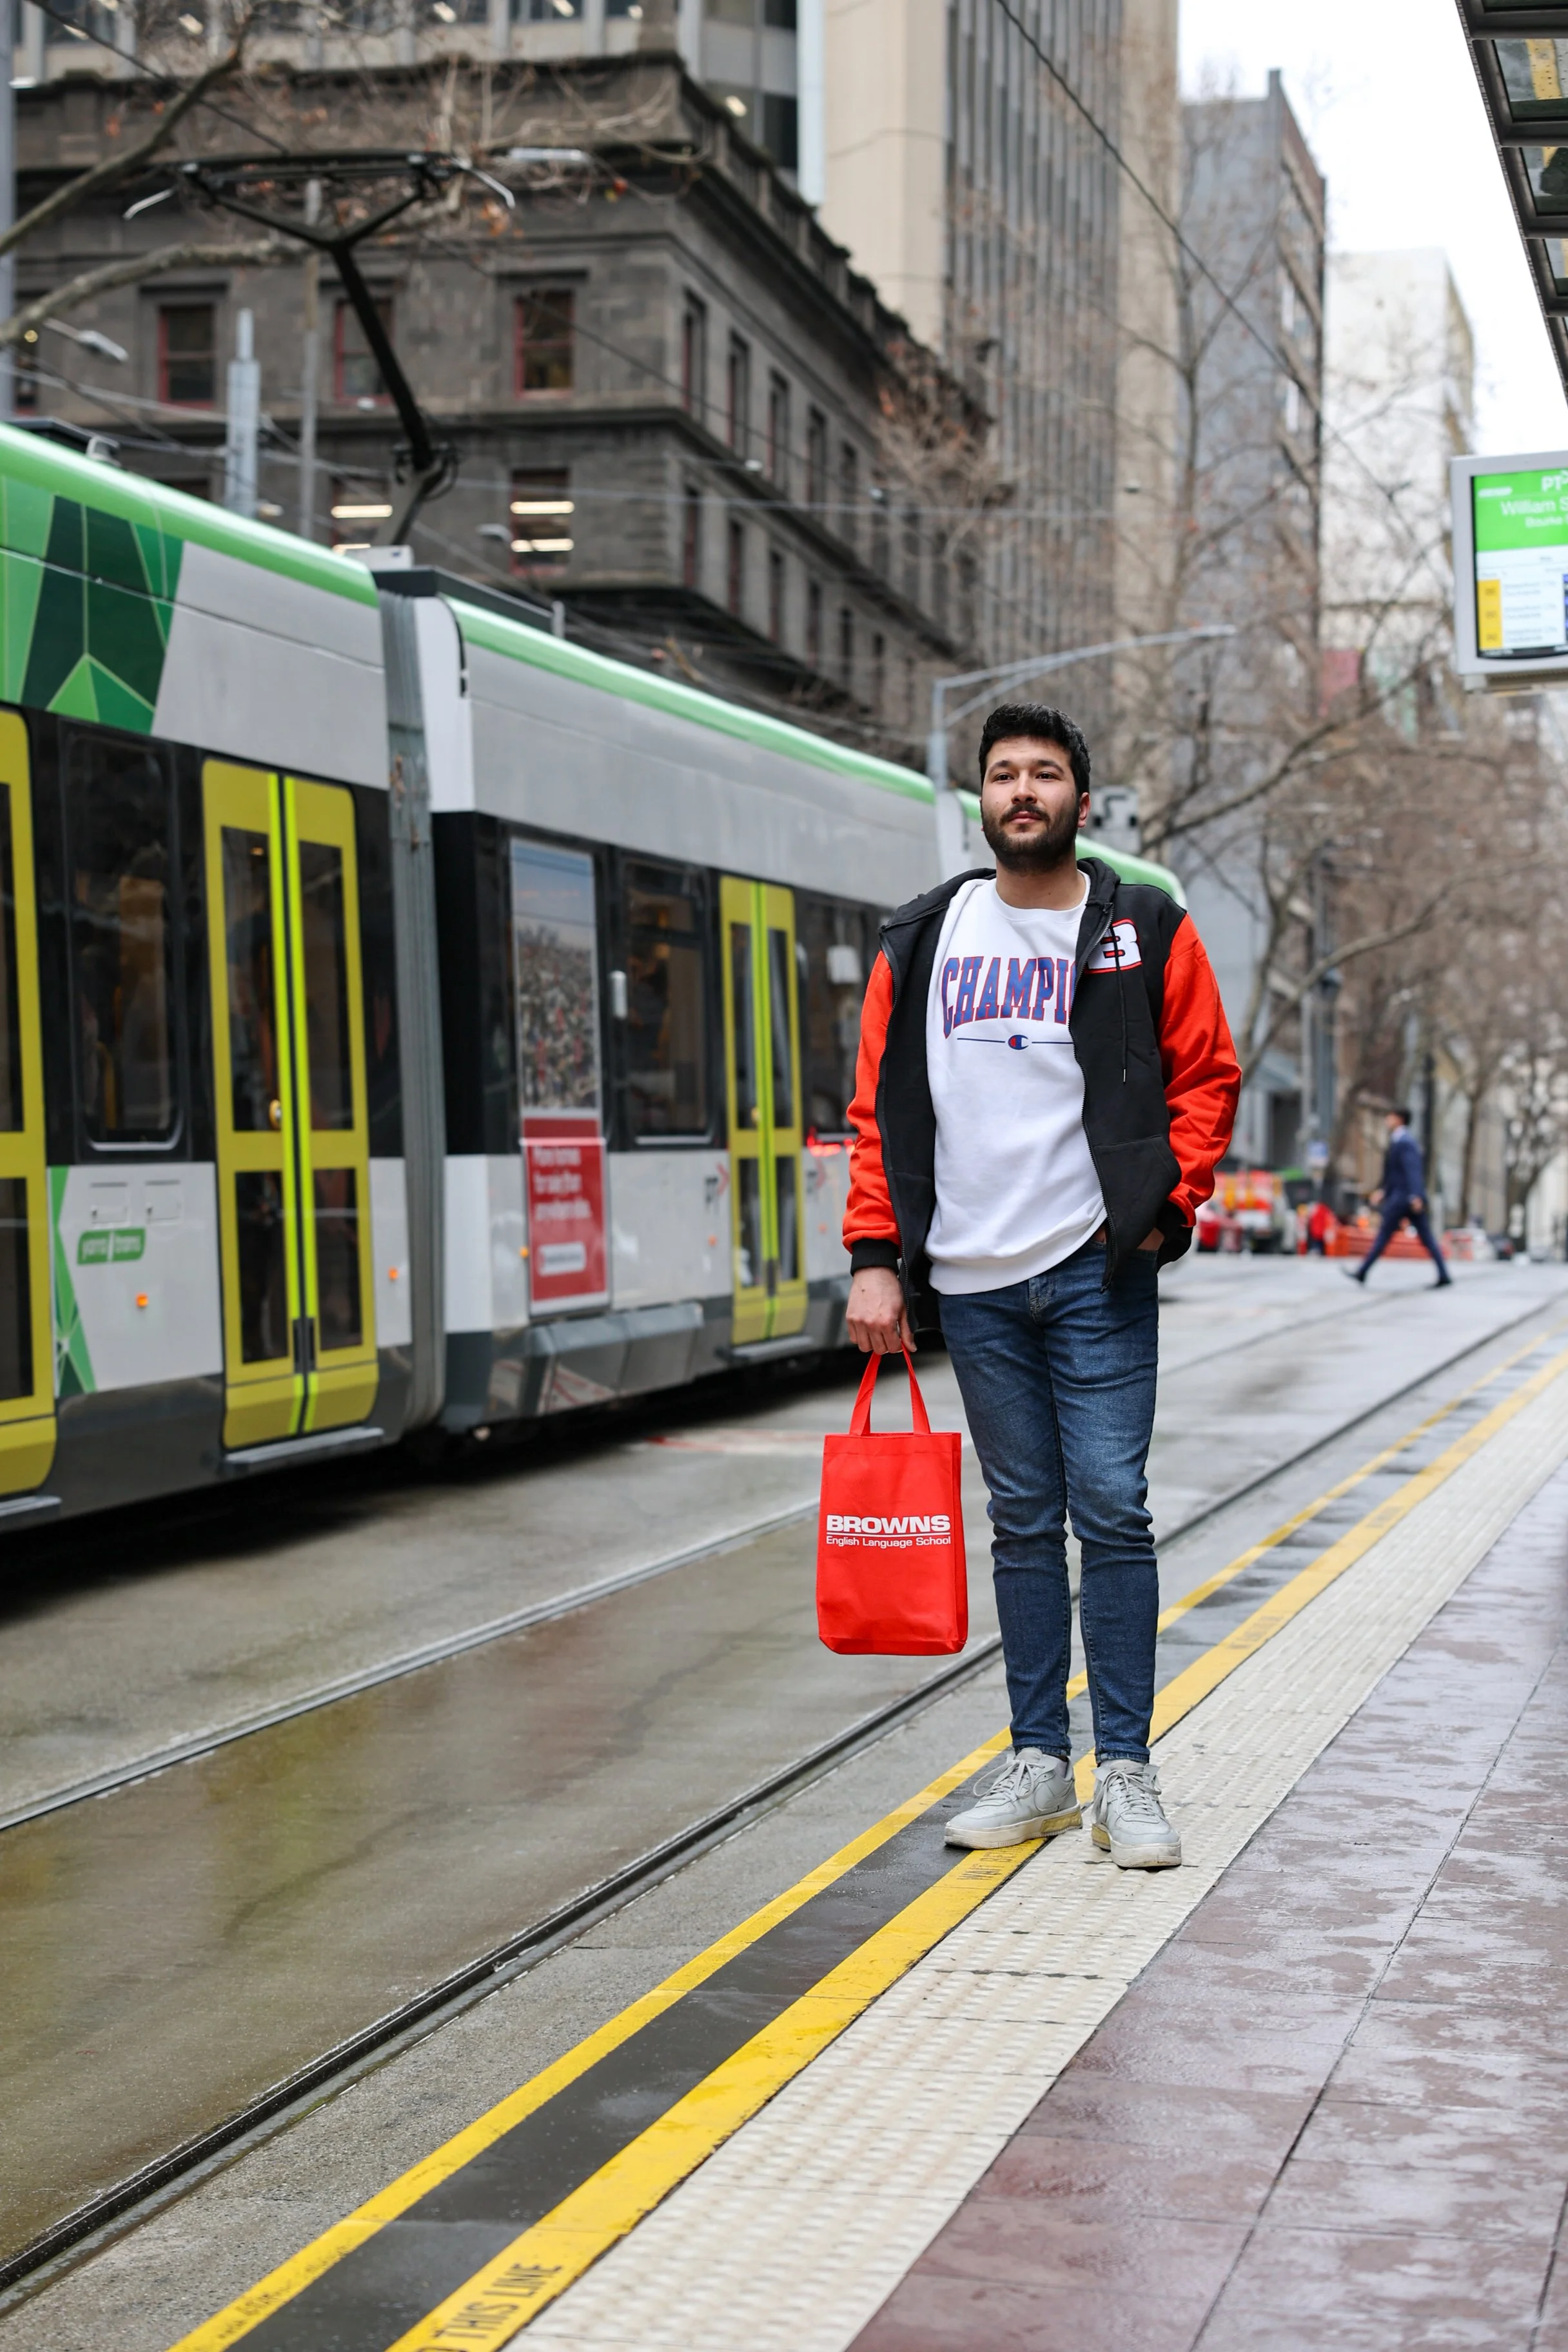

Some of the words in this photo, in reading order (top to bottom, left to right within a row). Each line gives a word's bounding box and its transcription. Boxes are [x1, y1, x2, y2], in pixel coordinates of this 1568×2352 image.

[1500, 500, 1556, 516] William
[827, 1514, 951, 1534] BROWNS
[826, 1536, 859, 1547] English
[863, 1538, 913, 1549] Language
[916, 1536, 951, 1546] School
[433, 2302, 519, 2338] THIS
[482, 2264, 562, 2297] LINE
